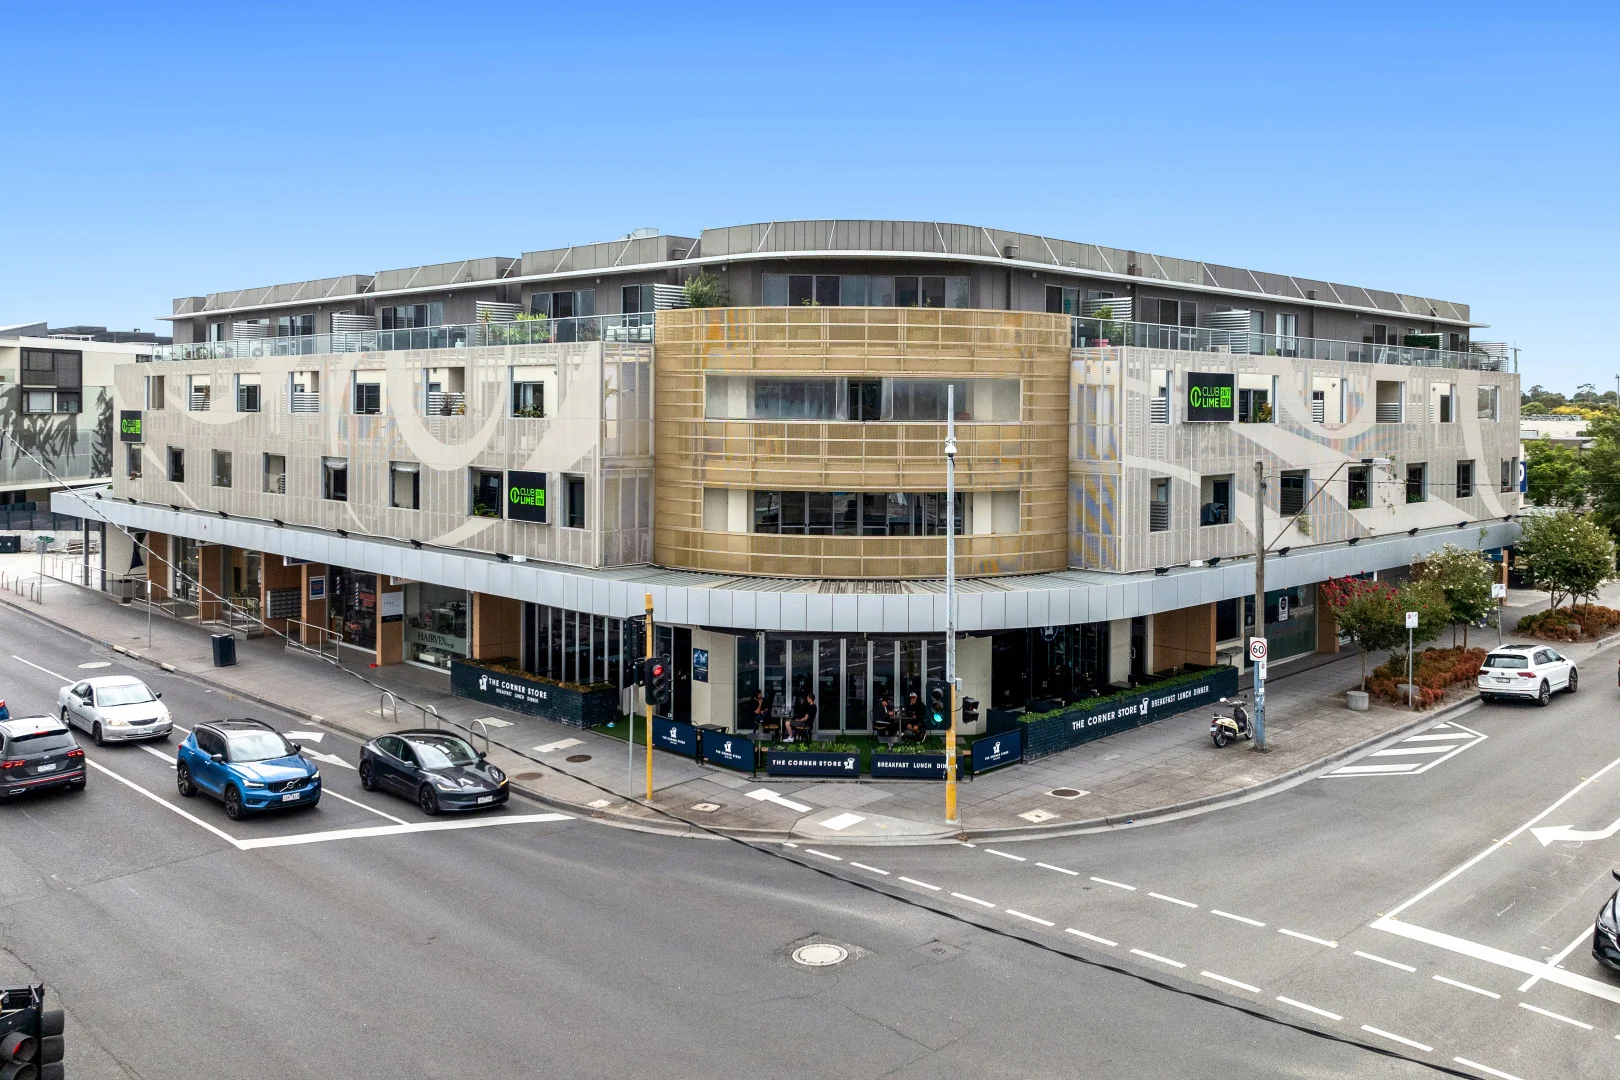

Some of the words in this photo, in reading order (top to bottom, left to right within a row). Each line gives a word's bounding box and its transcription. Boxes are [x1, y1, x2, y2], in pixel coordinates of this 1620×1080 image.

[1202, 386, 1220, 396] CLUB
[1202, 398, 1220, 408] LIME
[520, 488, 535, 496] CLUB
[520, 496, 535, 505] LIME
[1252, 644, 1264, 654] 60
[488, 678, 500, 687] THE
[501, 681, 526, 693] CORNER
[527, 688, 547, 699] STORE
[1072, 719, 1084, 730] THE
[1087, 711, 1116, 726] CORNER
[1118, 705, 1137, 718] STORE
[1151, 694, 1176, 708] BREAKFAST
[1177, 690, 1192, 700] LUNCH
[1194, 685, 1209, 696] DINNER
